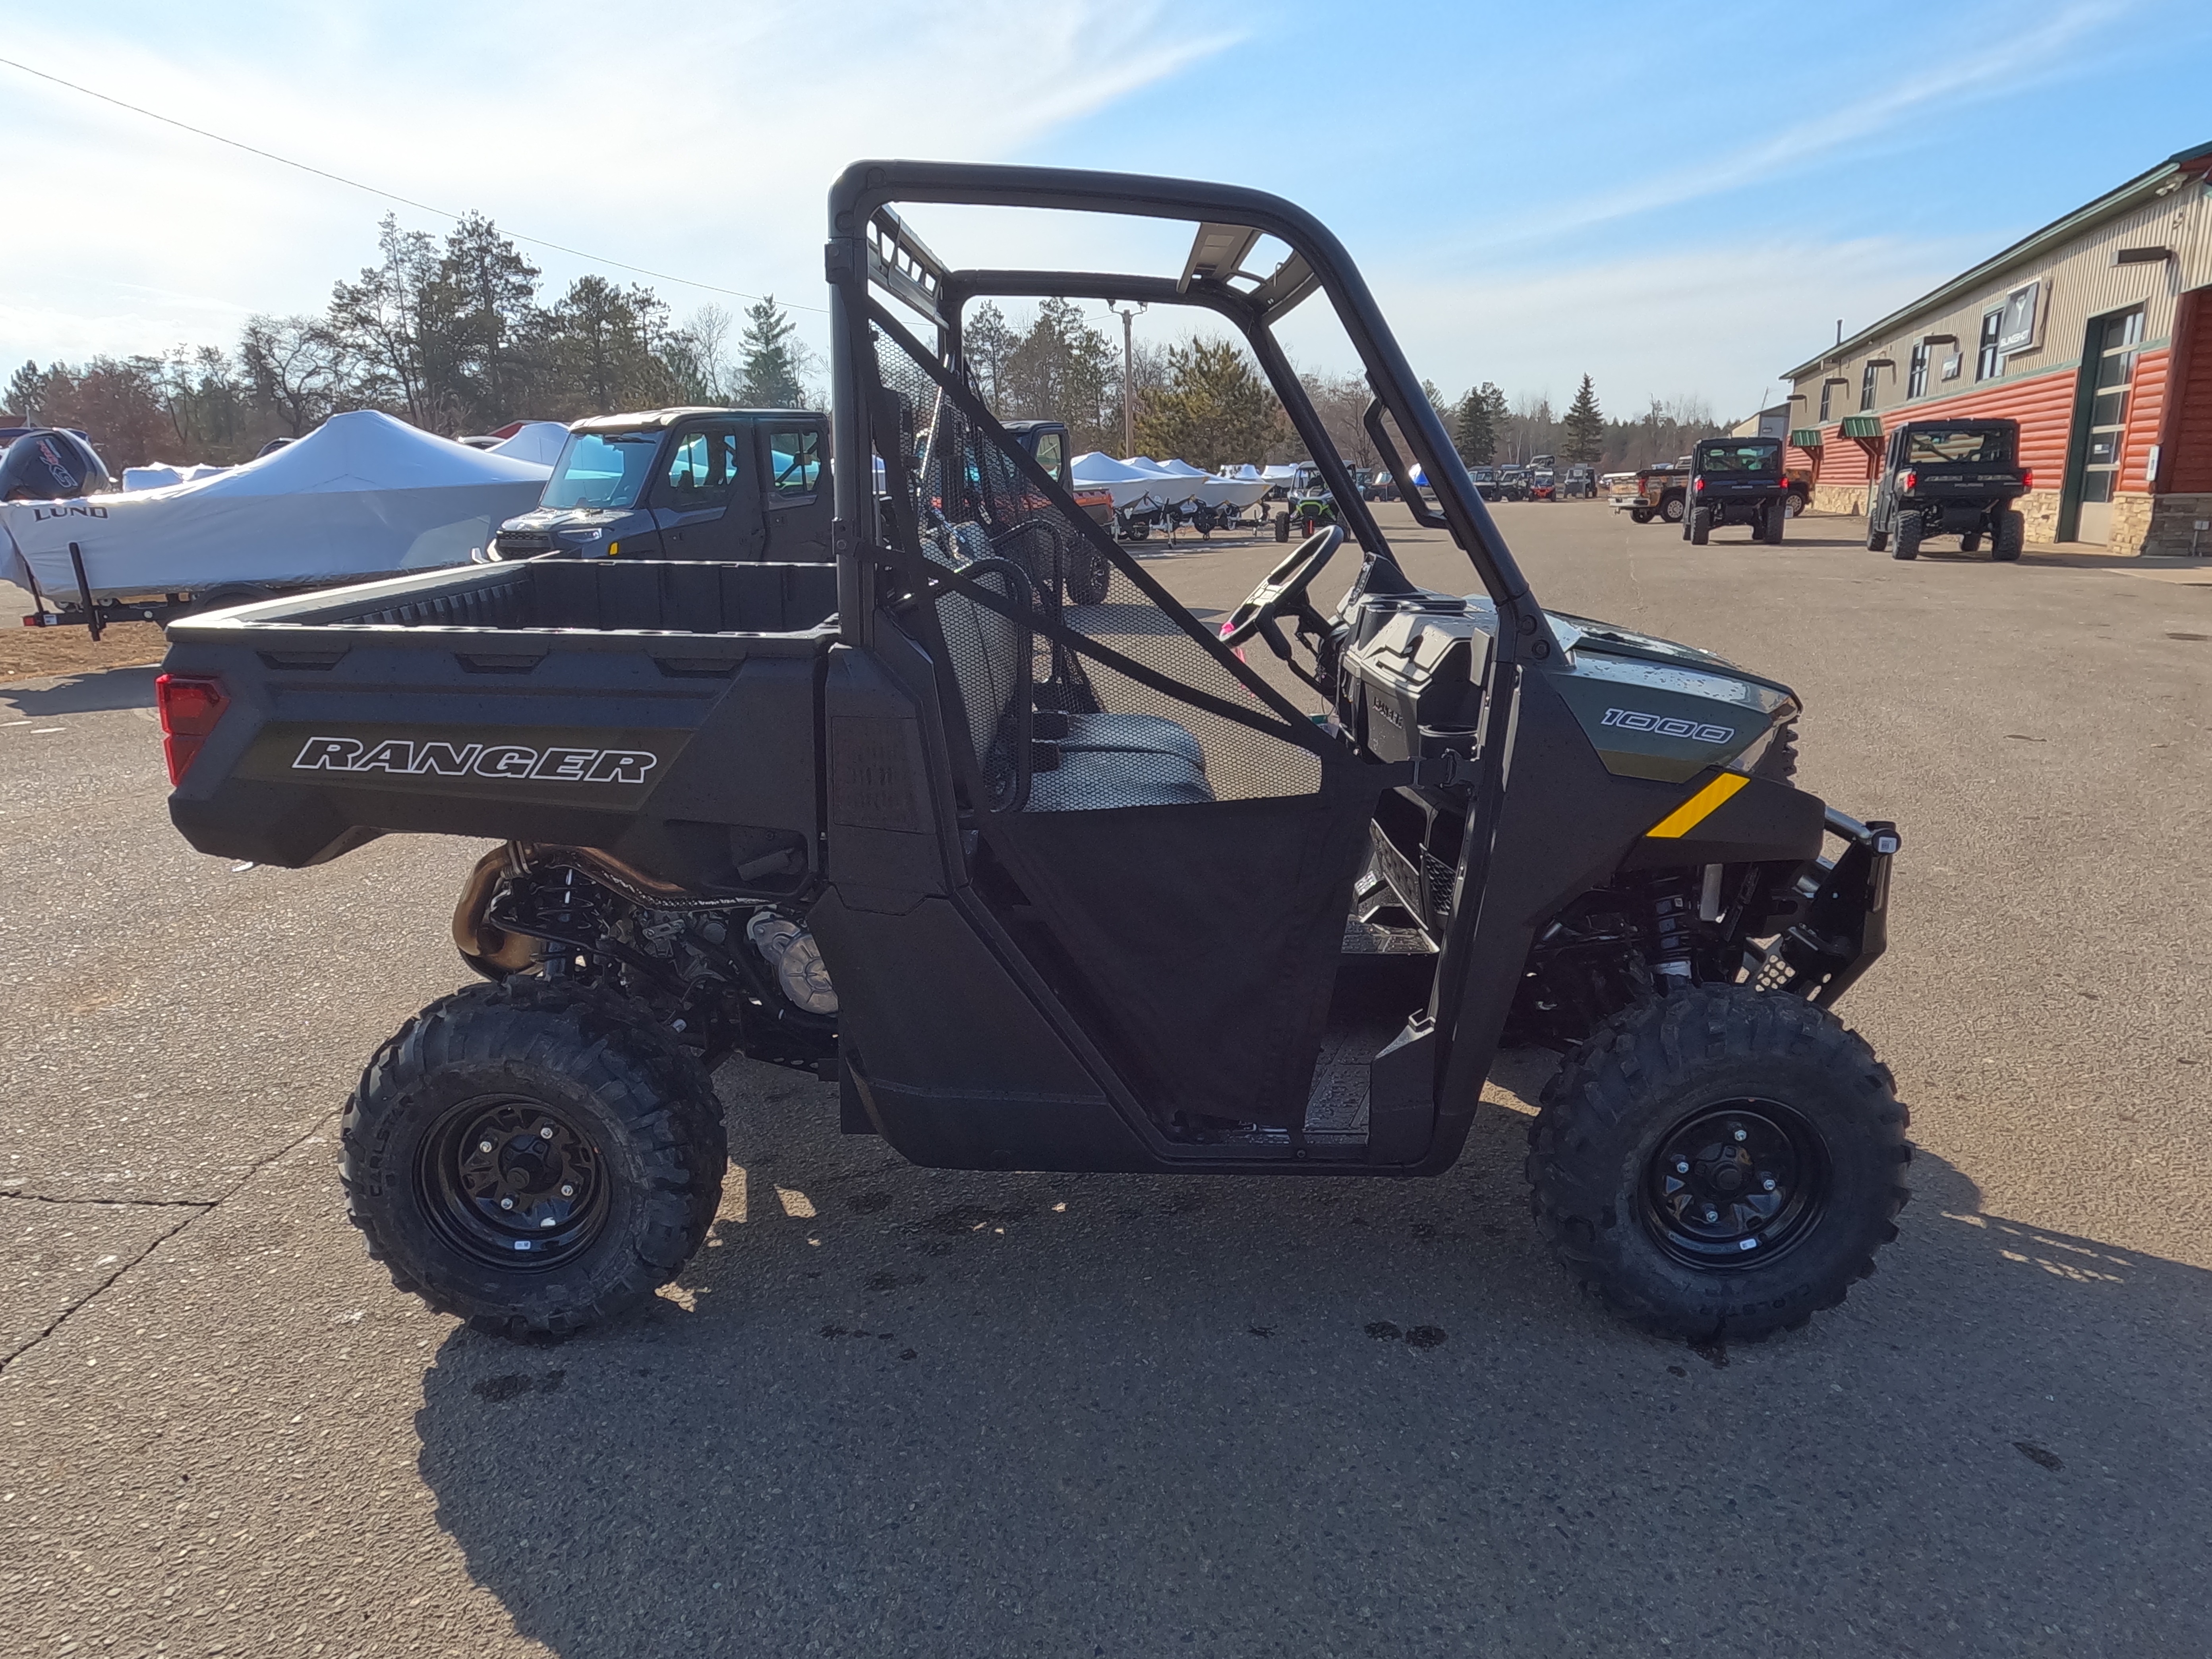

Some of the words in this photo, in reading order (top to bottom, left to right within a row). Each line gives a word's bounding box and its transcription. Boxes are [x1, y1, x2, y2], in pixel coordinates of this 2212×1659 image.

[33, 507, 108, 522] LUND
[1601, 708, 1734, 744] 1000
[292, 737, 657, 783] RANGER
